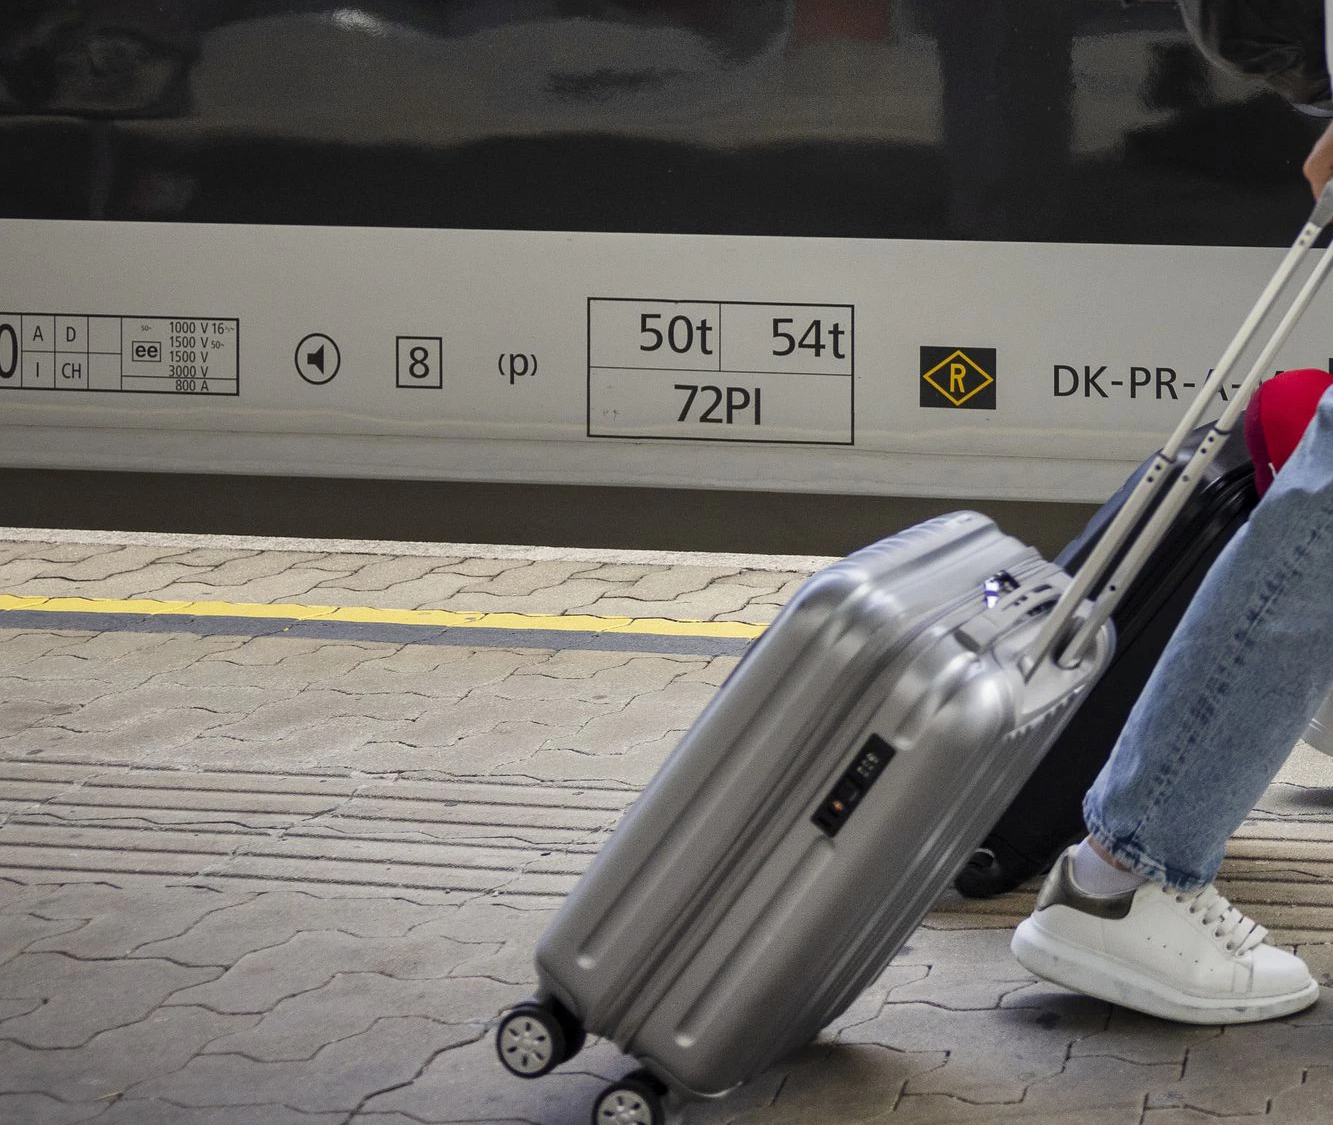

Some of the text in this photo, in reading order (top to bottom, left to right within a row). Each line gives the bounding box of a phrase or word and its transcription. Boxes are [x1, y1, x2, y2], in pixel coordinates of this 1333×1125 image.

[33, 325, 77, 343] A D
[169, 321, 196, 334] 1000
[200, 322, 209, 334] V
[639, 313, 713, 355] 50t
[169, 336, 196, 349] 1500
[200, 336, 209, 349] V
[772, 318, 846, 359] 54t
[135, 345, 159, 359] ee
[169, 350, 209, 363] 1500 V
[61, 362, 82, 379] CH
[168, 365, 209, 377] 3000 V
[408, 346, 430, 379] 8
[498, 352, 539, 385] (p)
[175, 379, 210, 392] 800 A
[950, 362, 967, 393] R
